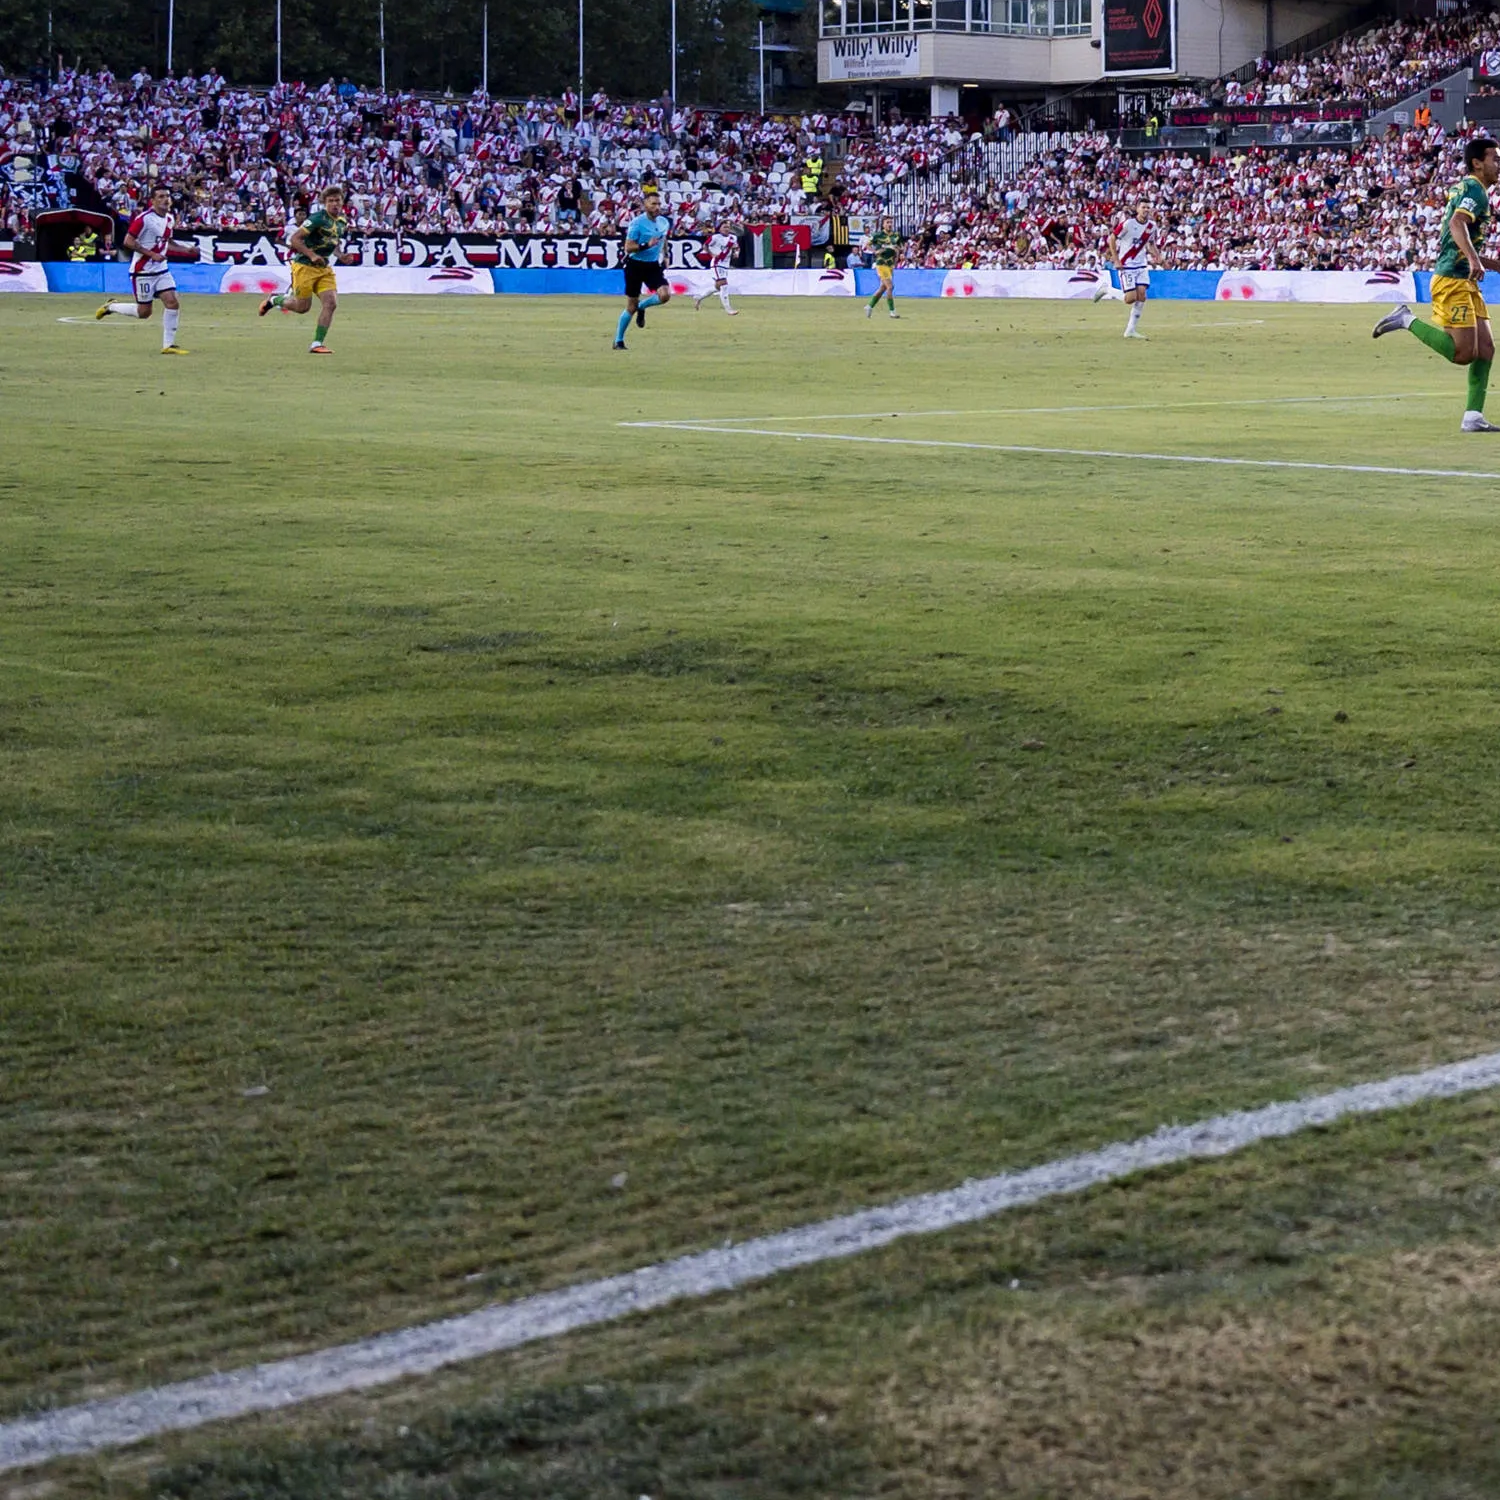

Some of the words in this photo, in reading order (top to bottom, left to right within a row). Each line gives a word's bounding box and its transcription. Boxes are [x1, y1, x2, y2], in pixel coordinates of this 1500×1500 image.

[833, 37, 873, 60] Willy!
[878, 34, 917, 58] Willy!
[496, 238, 706, 269] MEJR
[140, 282, 150, 294] 10
[1451, 306, 1468, 323] 27
